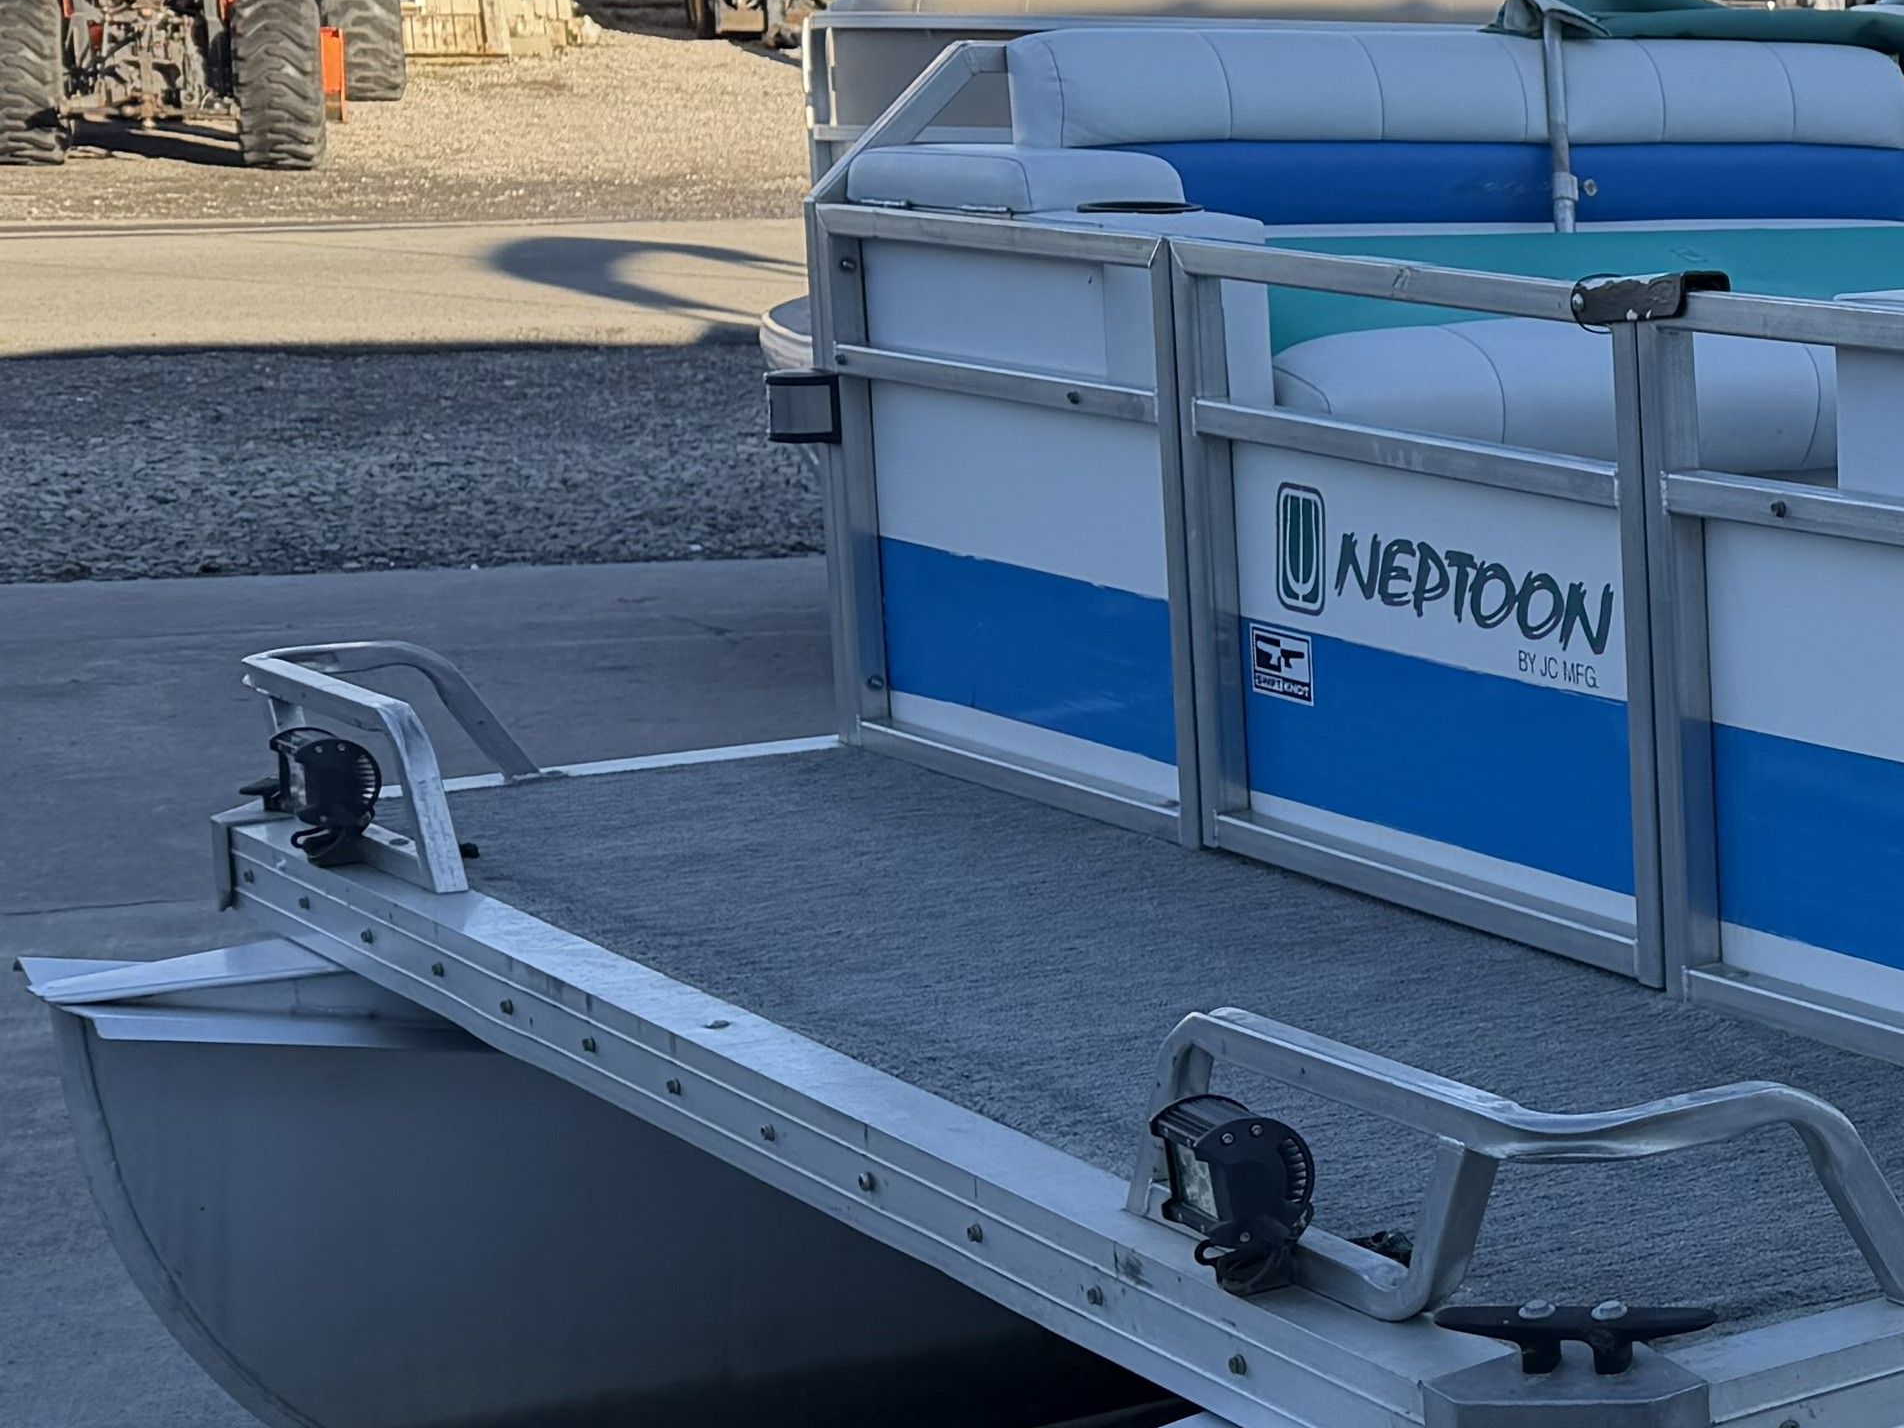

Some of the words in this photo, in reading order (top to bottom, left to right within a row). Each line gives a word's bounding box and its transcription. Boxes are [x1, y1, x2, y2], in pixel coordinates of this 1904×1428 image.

[1334, 531, 1614, 655] NEPTOON
[1518, 649, 1536, 673] BY
[1540, 657, 1559, 679] JC
